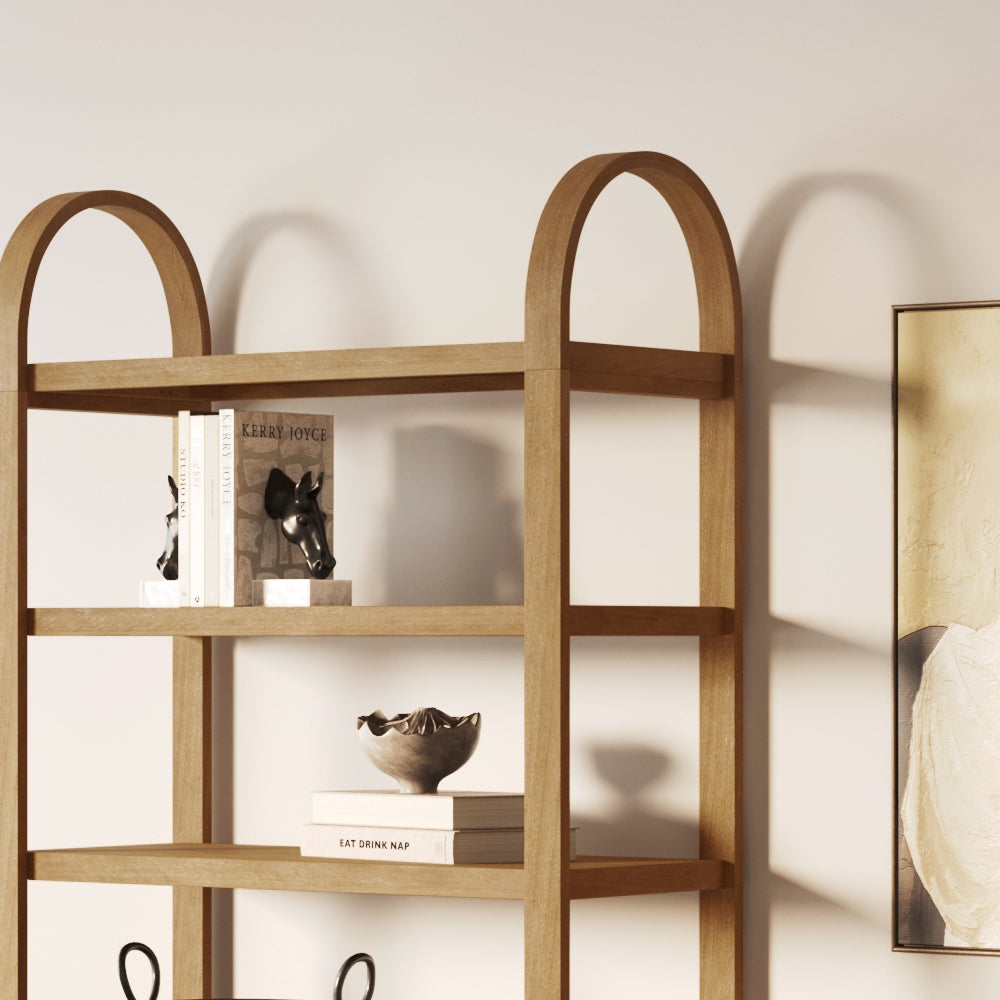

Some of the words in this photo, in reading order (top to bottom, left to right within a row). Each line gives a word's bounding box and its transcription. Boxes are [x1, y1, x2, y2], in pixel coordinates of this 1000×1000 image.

[222, 414, 232, 459] KERRY
[242, 423, 284, 440] KERRY
[289, 427, 328, 442] JOYCE
[179, 448, 187, 497] STUDIO
[179, 501, 187, 519] KO
[339, 838, 356, 848] EAT
[359, 839, 388, 850] DRINK
[390, 840, 410, 851] NAP
